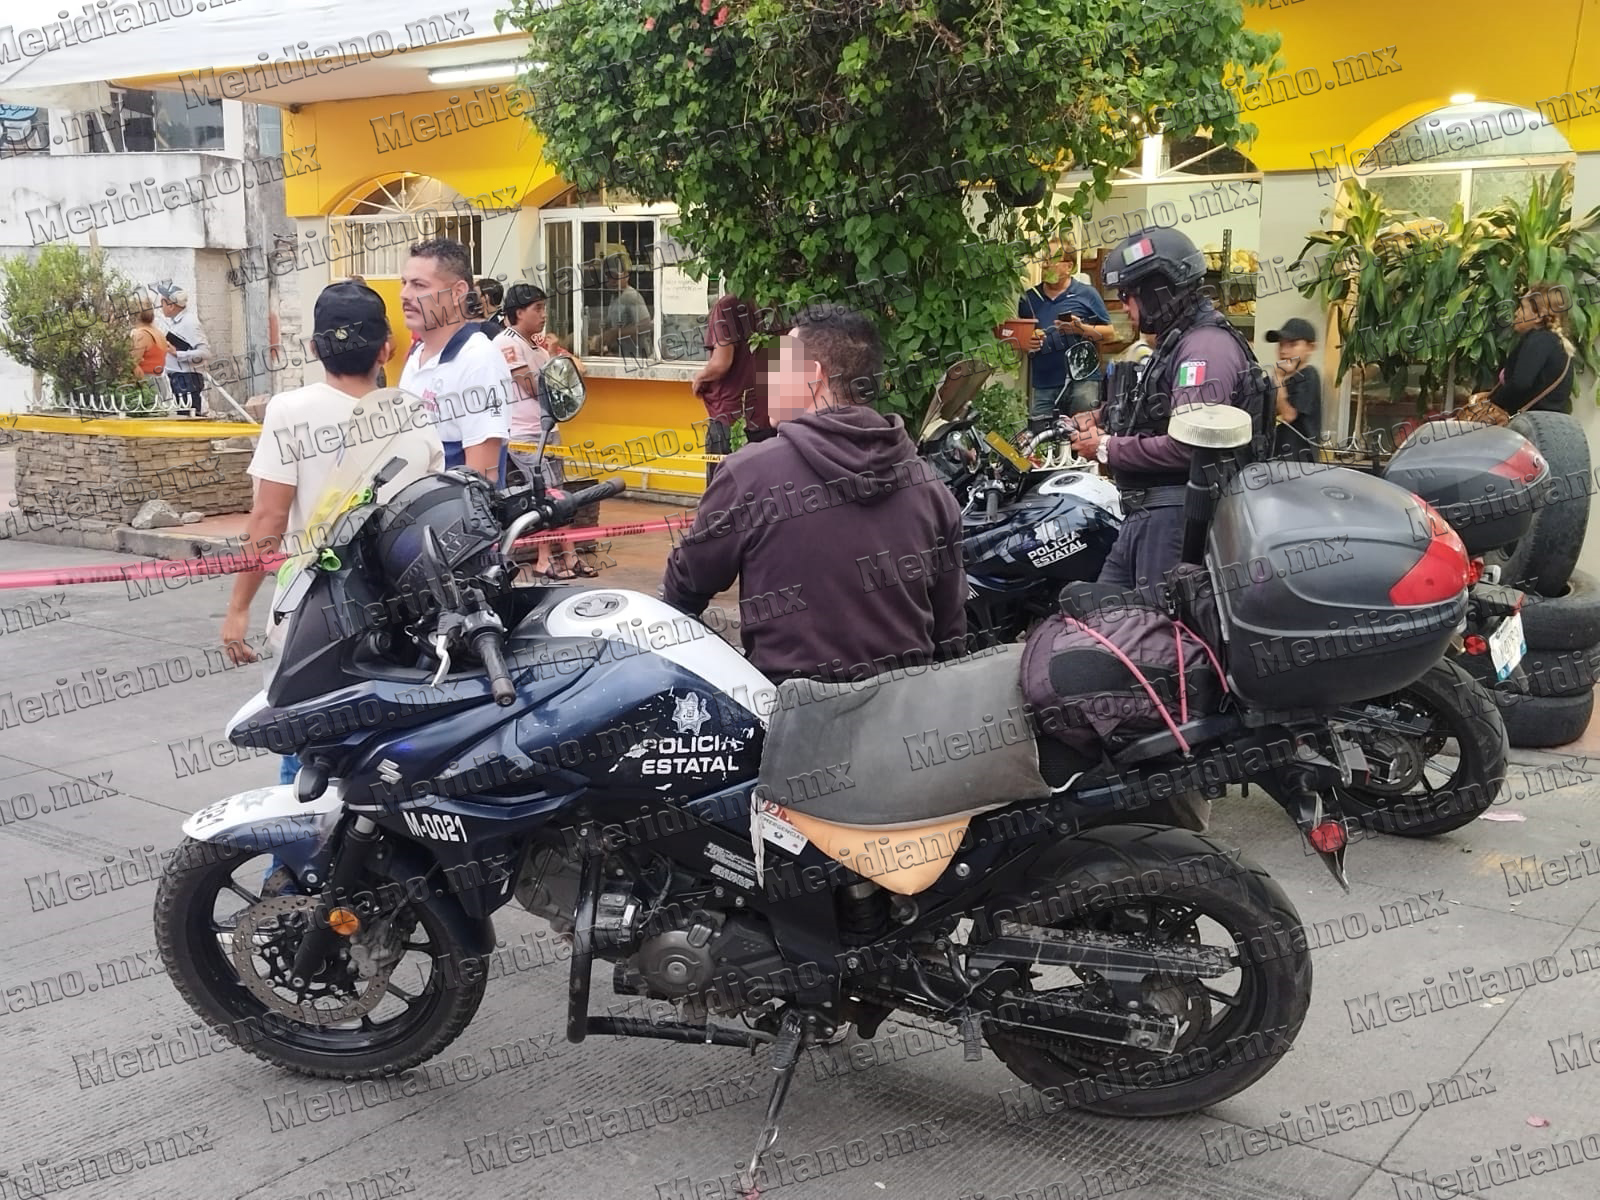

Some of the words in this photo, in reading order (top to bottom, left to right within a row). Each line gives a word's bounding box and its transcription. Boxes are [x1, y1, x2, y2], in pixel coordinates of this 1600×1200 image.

[1027, 530, 1081, 560] POLICIA
[1032, 540, 1088, 567] ESTATAL
[641, 755, 739, 775] ESTATAL
[403, 811, 468, 843] M-0021
